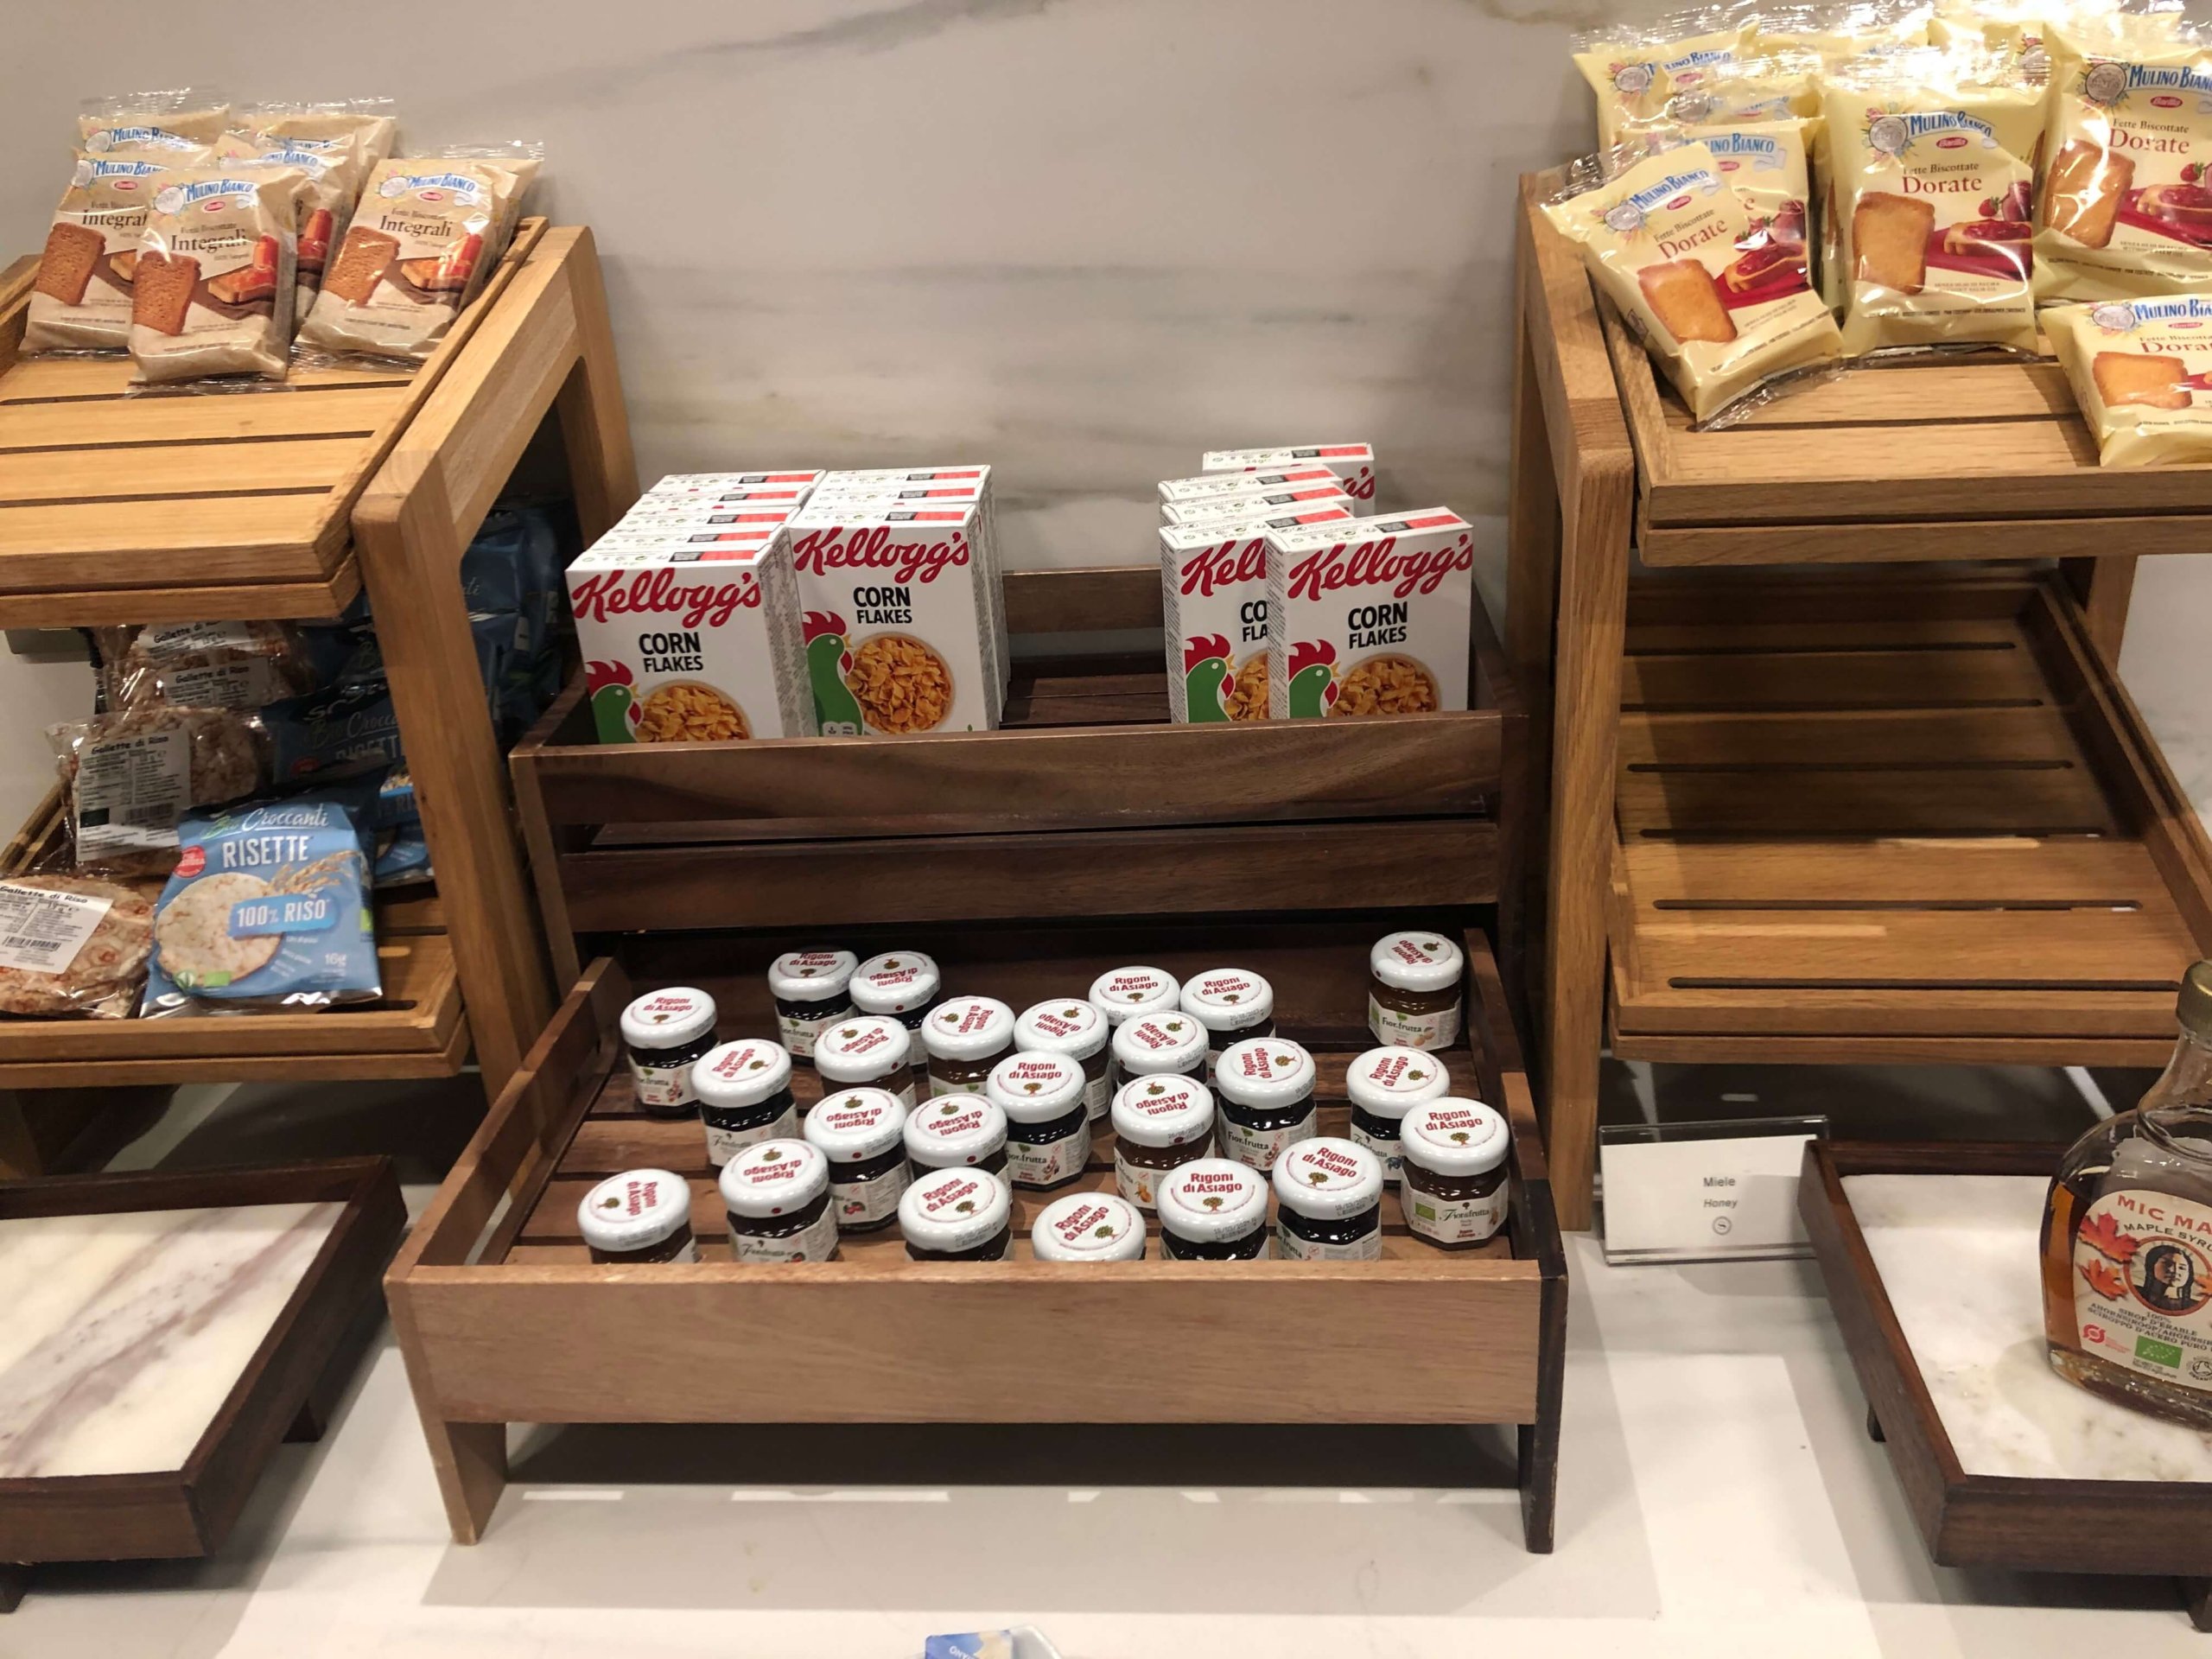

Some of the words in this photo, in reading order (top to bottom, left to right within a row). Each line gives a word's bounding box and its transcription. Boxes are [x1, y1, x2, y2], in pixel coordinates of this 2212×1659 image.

[2129, 65, 2178, 88] MULINO
[1910, 112, 1956, 136] MULINO
[2113, 118, 2137, 129] Fette
[2140, 121, 2190, 133] Biscottate
[1732, 133, 1775, 153] BIANCO
[2109, 129, 2190, 154] Dorate
[96, 161, 133, 175] MULINO
[1930, 162, 1980, 174] Biscottate
[187, 183, 219, 201] MULINO
[219, 179, 253, 194] BIANCO
[441, 173, 475, 192] BIANCO
[1630, 183, 1671, 212] MULINO
[1665, 170, 1708, 190] BIANCO
[1903, 175, 1982, 194] Dorate
[380, 215, 452, 238] Integrali
[1653, 226, 1675, 242] Fette
[1675, 208, 1715, 232] Biscottate
[171, 228, 247, 253] Integrali
[1657, 218, 1728, 259] Dorate
[2134, 304, 2186, 320] MULINO
[2190, 299, 2212, 317] BIA
[793, 525, 969, 584] Kellogg's
[1287, 533, 1474, 601] Kellogg's
[571, 568, 761, 628] Kellogg's
[853, 586, 911, 607] CORN
[856, 608, 912, 624] FLAKES
[1240, 600, 1268, 625] CO
[1348, 601, 1408, 632] CORN
[1243, 621, 1268, 642] FLA
[1349, 624, 1408, 649] FLAKES
[639, 632, 702, 655] CORN
[643, 655, 704, 672] FLAKES
[346, 711, 397, 739] Crocca
[241, 803, 329, 832] Croccanti
[222, 835, 310, 868] RISETTE
[0, 886, 45, 898] Gallette
[65, 894, 88, 904] Riso
[237, 905, 280, 928] 100%
[283, 899, 327, 924] RISO
[869, 969, 906, 982] Asiago
[877, 976, 912, 987] Rigoni
[1115, 976, 1151, 985] Rigoni
[1204, 976, 1241, 988] Rigoni
[1122, 982, 1159, 991] Asiago
[1213, 982, 1251, 995] Asiago
[655, 997, 691, 1006] Rigoni
[655, 1004, 692, 1013] Asiago
[1035, 1021, 1068, 1037] Rigoni
[1038, 1013, 1071, 1029] Asiago
[1134, 1029, 1162, 1049] Rigoni
[1141, 1022, 1169, 1042] Asiago
[1017, 1062, 1057, 1072] Rigoni
[1242, 1052, 1256, 1077] Rigoni
[1255, 1047, 1270, 1071] Asiago
[1390, 1056, 1409, 1081] Asiago
[1020, 1071, 1062, 1080] Asiago
[1370, 1058, 1392, 1080] Rigoni
[1135, 1096, 1176, 1109] Asiago
[1178, 1092, 1189, 1101] di
[826, 1110, 868, 1122] Asiago
[870, 1108, 882, 1116] di
[971, 1110, 982, 1119] di
[1147, 1102, 1188, 1116] Rigoni
[1428, 1109, 1471, 1122] Rigoni
[835, 1117, 875, 1130] Rigoni
[929, 1114, 969, 1130] Asiago
[939, 1120, 981, 1136] Rigoni
[1426, 1122, 1439, 1131] di
[1440, 1117, 1483, 1130] Asiago
[790, 1160, 802, 1168] di
[1302, 1154, 1314, 1163] di
[1313, 1158, 1357, 1178] Asiago
[1317, 1147, 1357, 1166] Rigoni
[743, 1162, 787, 1176] Asiago
[751, 1170, 794, 1184] Rigoni
[1191, 1173, 1233, 1184] Rigoni
[922, 1178, 964, 1201] Rigoni
[1183, 1184, 1195, 1193] di
[1197, 1183, 1243, 1193] Asiago
[1703, 1177, 1736, 1187] Miele
[627, 1190, 641, 1216] Asiago
[645, 1181, 658, 1208] Rigoni
[926, 1201, 940, 1212] di
[939, 1182, 979, 1207] Asiago
[1703, 1198, 1738, 1209] Honey
[1054, 1205, 1092, 1230] Rigoni
[1064, 1230, 1077, 1241] di
[1075, 1206, 1109, 1234] Asiago
[2117, 1194, 2166, 1221] MIC
[2173, 1214, 2212, 1235] MA
[2123, 1223, 2174, 1236] MAPLE
[2177, 1231, 2212, 1251] SYRU
[2118, 1307, 2148, 1321] SIROP
[2088, 1306, 2133, 1330] SCIROPPO
[2135, 1326, 2179, 1344] D'ACERO
[2180, 1340, 2208, 1351] PURO
